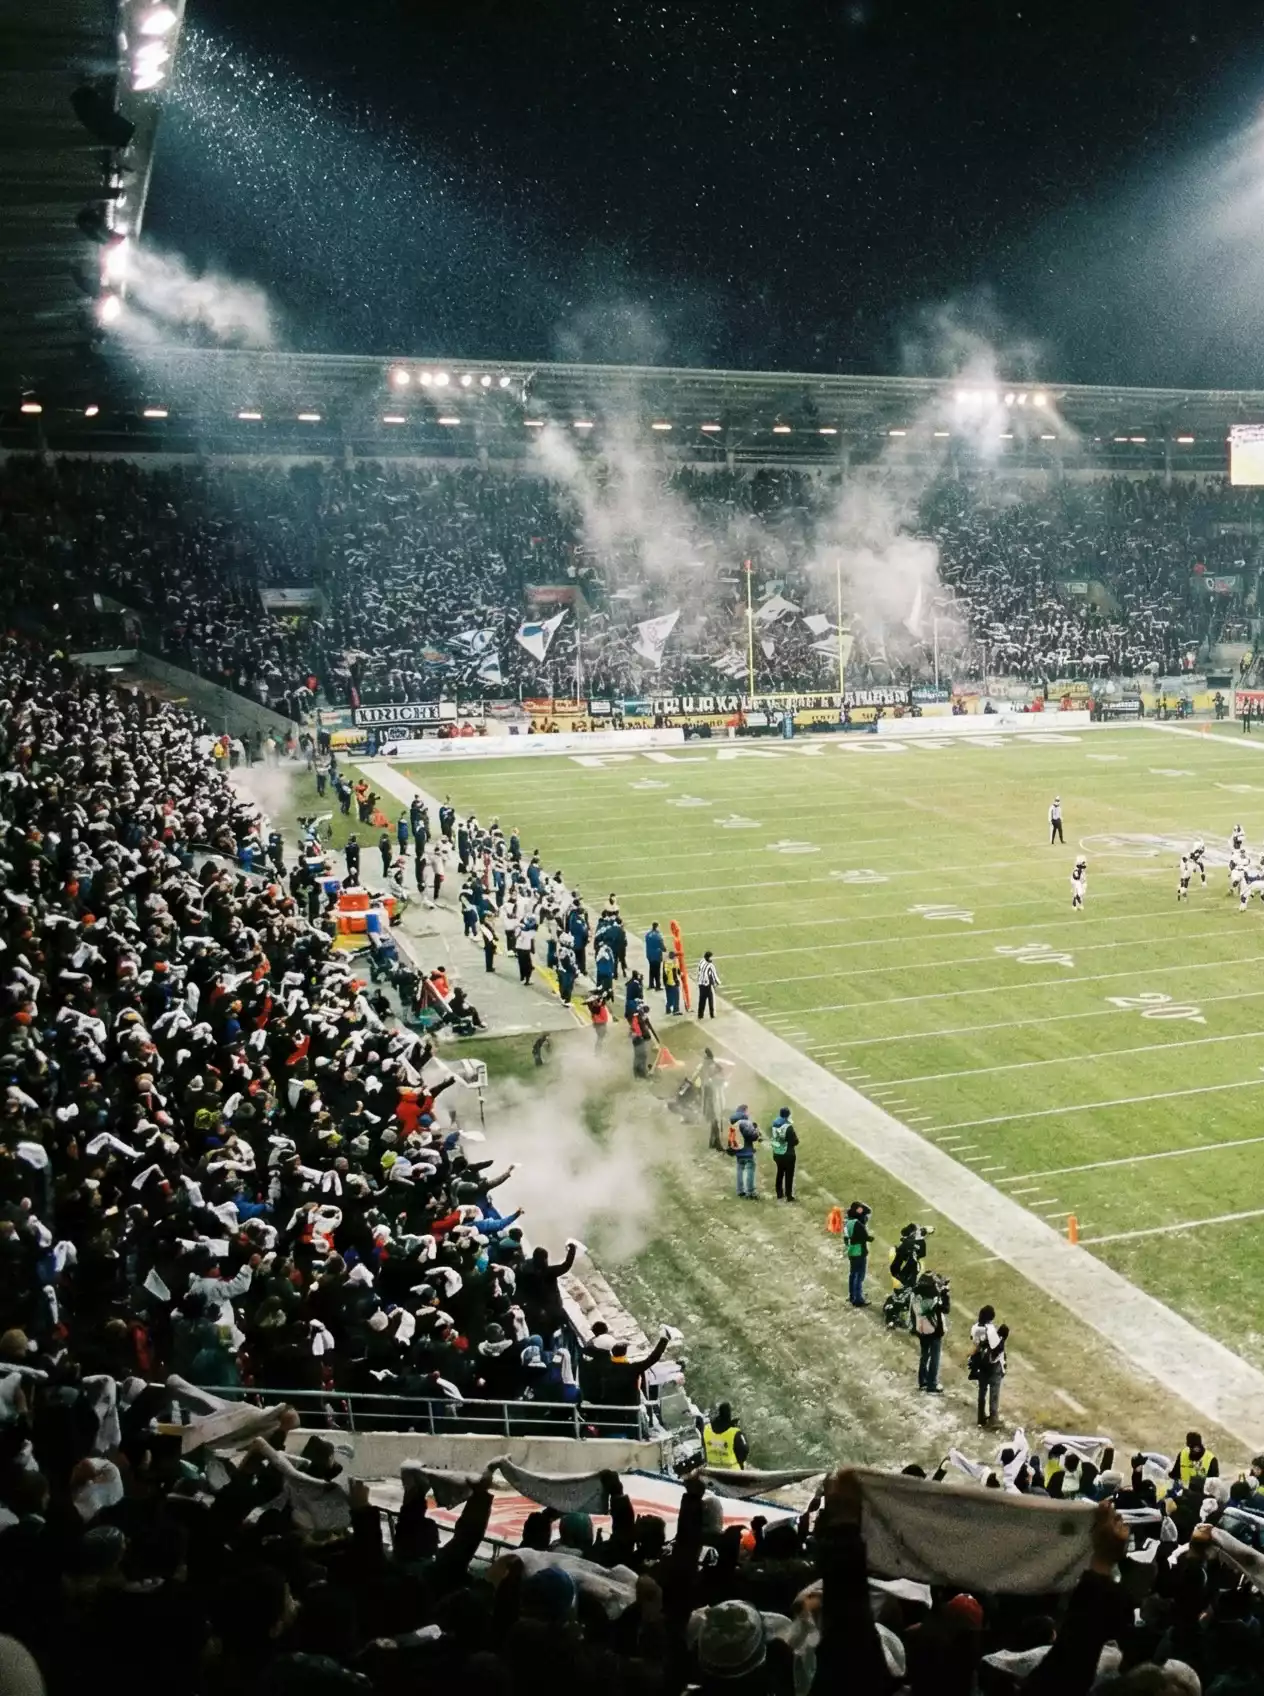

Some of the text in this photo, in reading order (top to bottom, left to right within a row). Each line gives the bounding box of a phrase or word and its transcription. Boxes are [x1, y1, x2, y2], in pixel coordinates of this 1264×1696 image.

[567, 733, 1084, 768] PLAYOFFS
[994, 943, 1072, 965] 30
[1105, 992, 1201, 1021] 20
